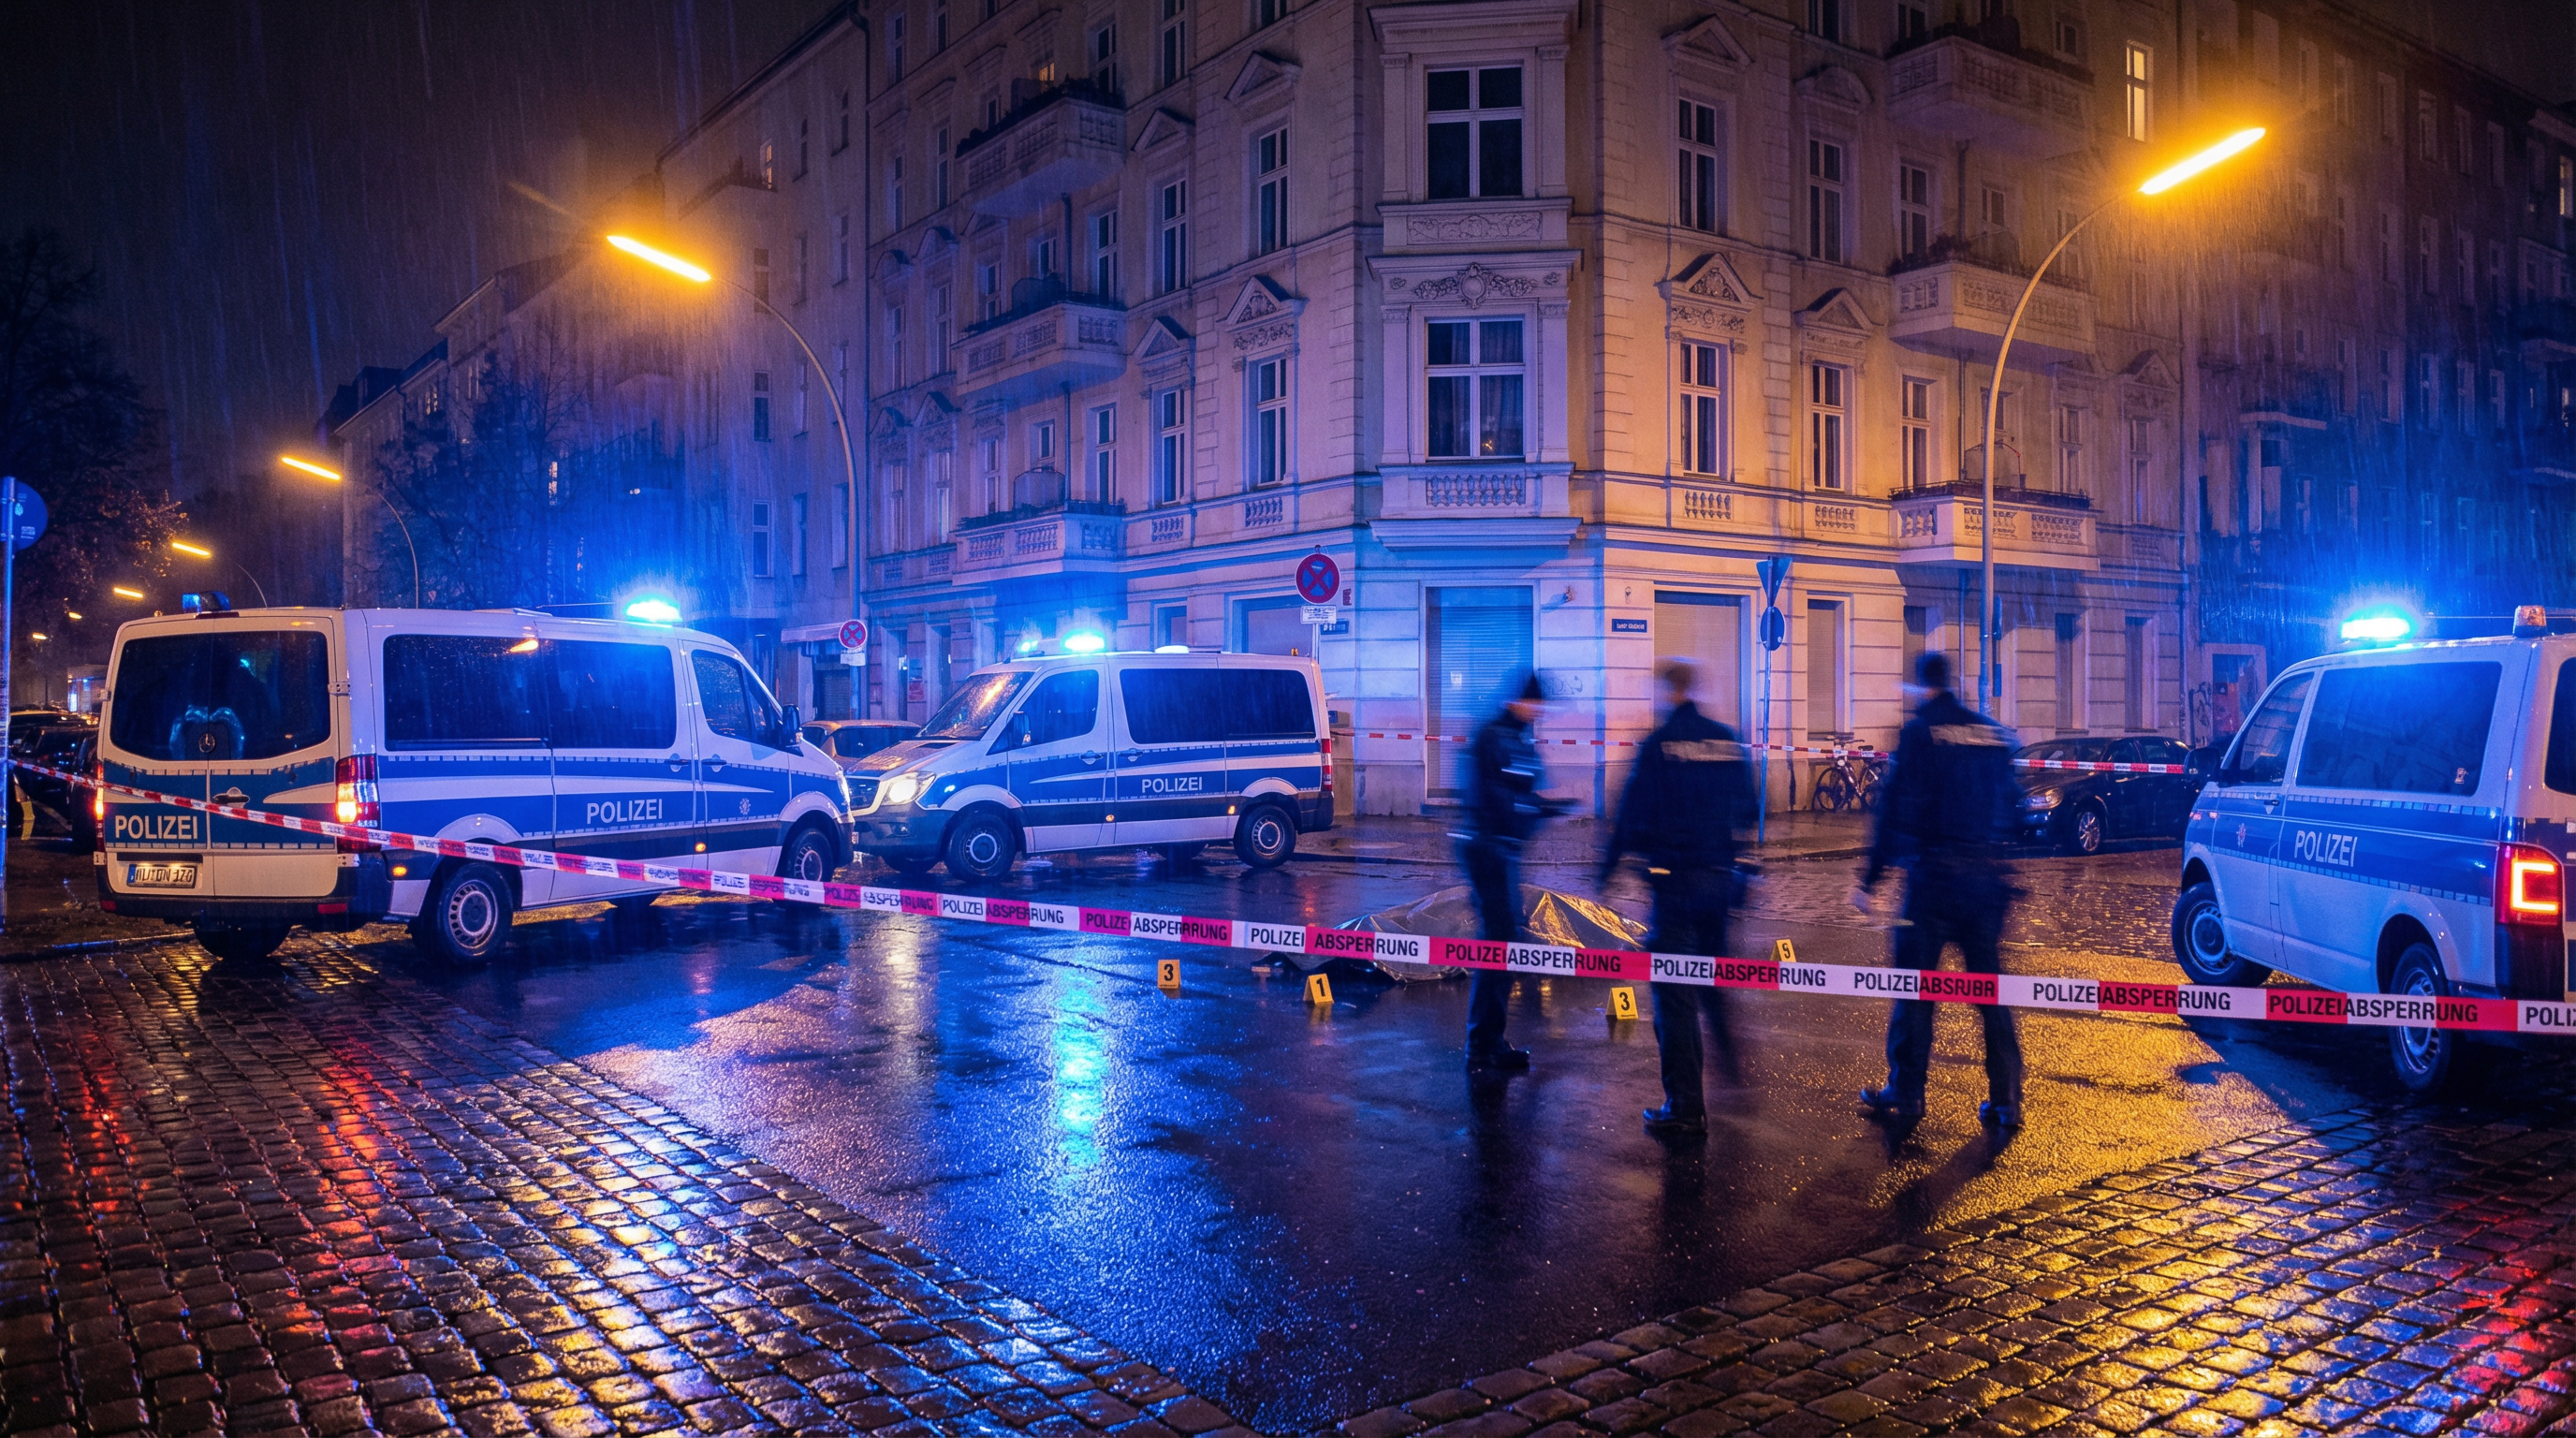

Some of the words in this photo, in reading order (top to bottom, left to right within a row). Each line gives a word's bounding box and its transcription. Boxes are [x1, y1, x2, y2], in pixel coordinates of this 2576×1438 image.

[1141, 775, 1203, 795] POLIZEI
[587, 798, 663, 825] POLIZEI
[114, 814, 198, 841] POLIZEI
[2293, 829, 2359, 868] POLIZEI
[1164, 963, 1174, 982] 3
[1316, 977, 1326, 997] 1
[1619, 991, 1631, 1011] 3
